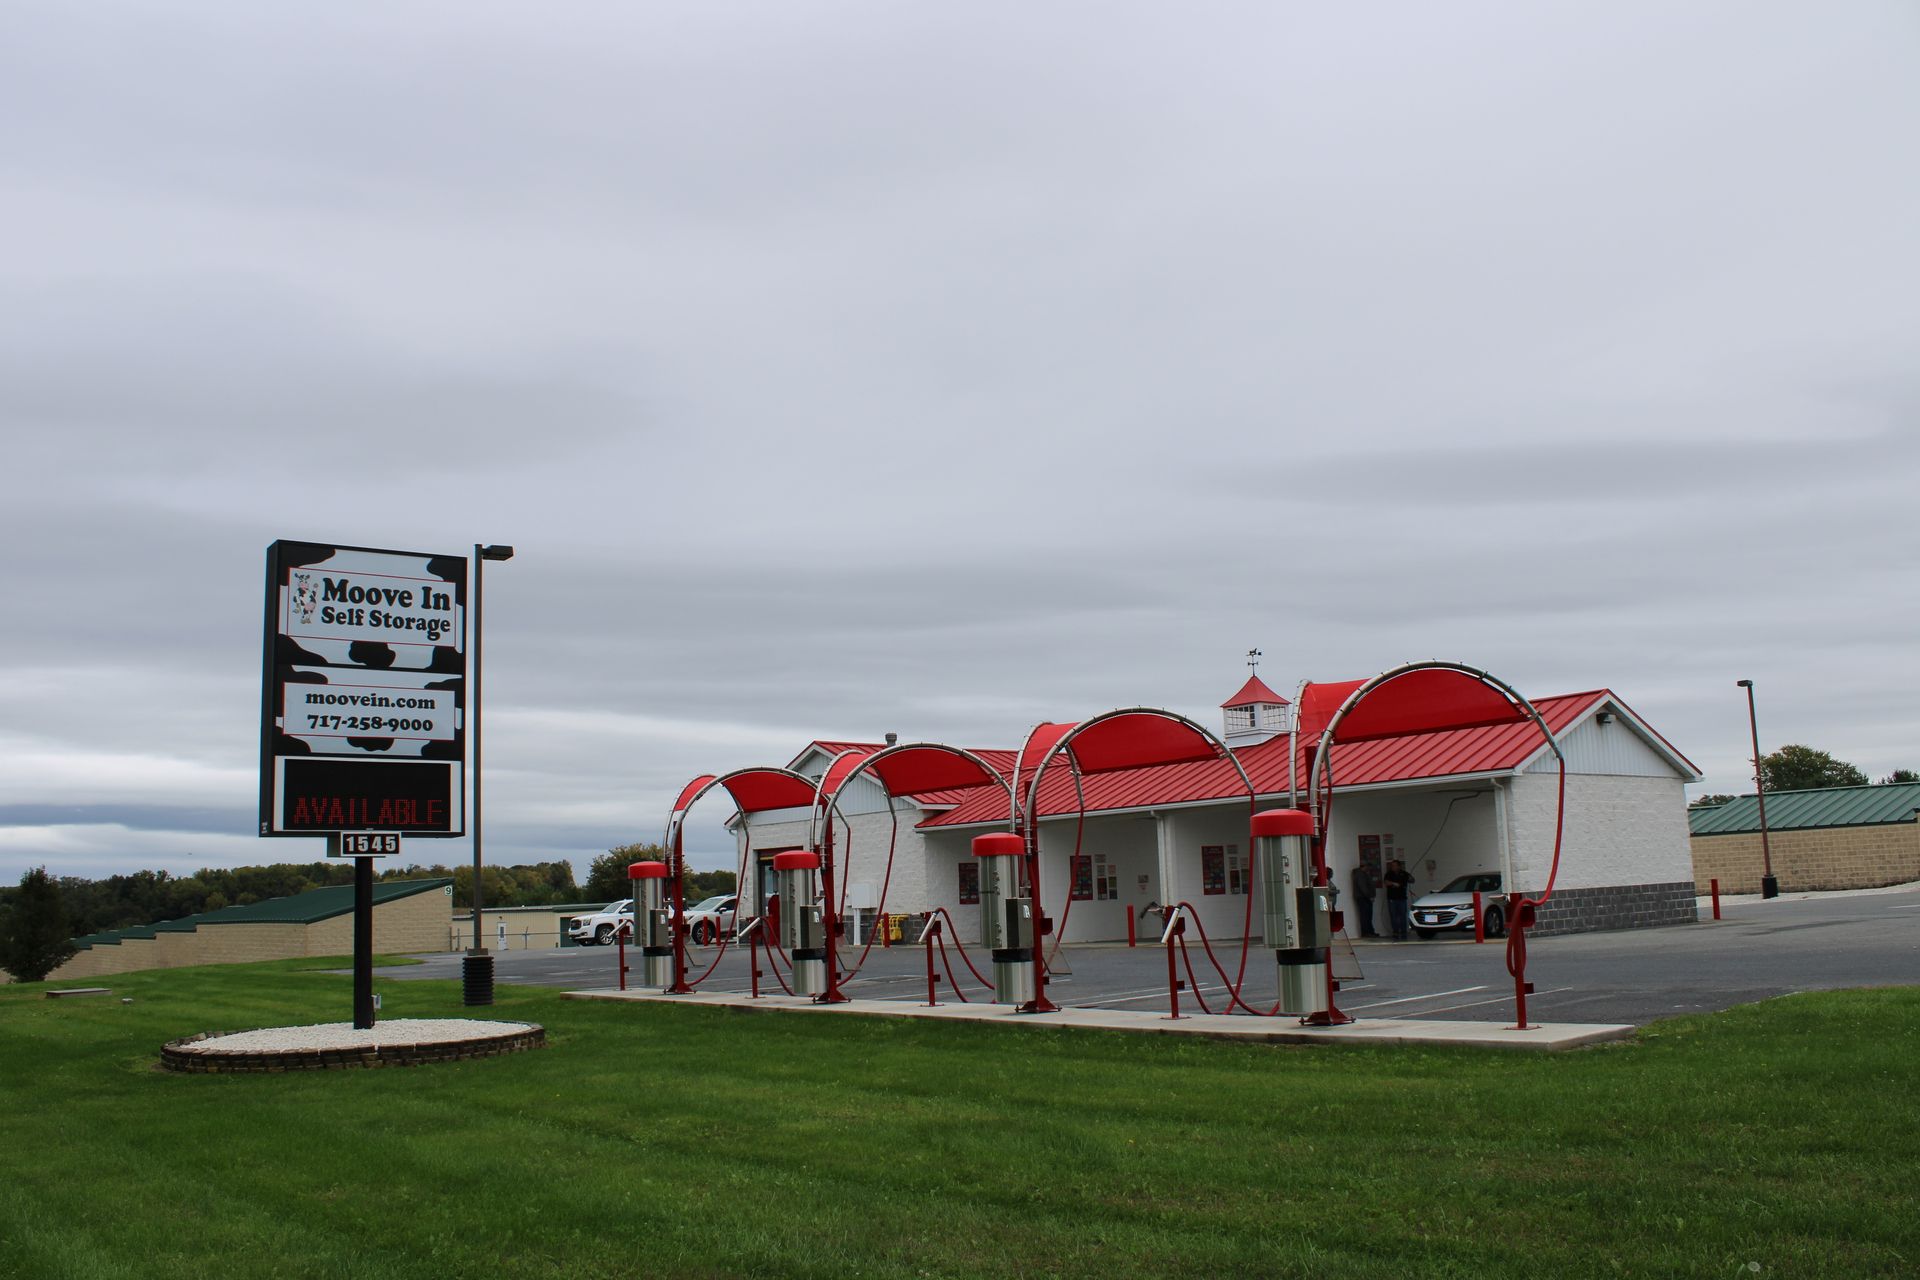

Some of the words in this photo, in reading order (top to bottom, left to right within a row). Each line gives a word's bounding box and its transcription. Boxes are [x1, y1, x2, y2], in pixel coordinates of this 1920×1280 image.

[322, 578, 413, 608] Moove
[422, 586, 450, 610] In
[321, 607, 364, 626] Self
[369, 610, 450, 640] Storage
[305, 691, 435, 710] moovein.com
[307, 714, 433, 731] 717-258-9000
[294, 797, 442, 825] AVAILABLE
[346, 836, 396, 852] 1545
[445, 886, 452, 896] 9
